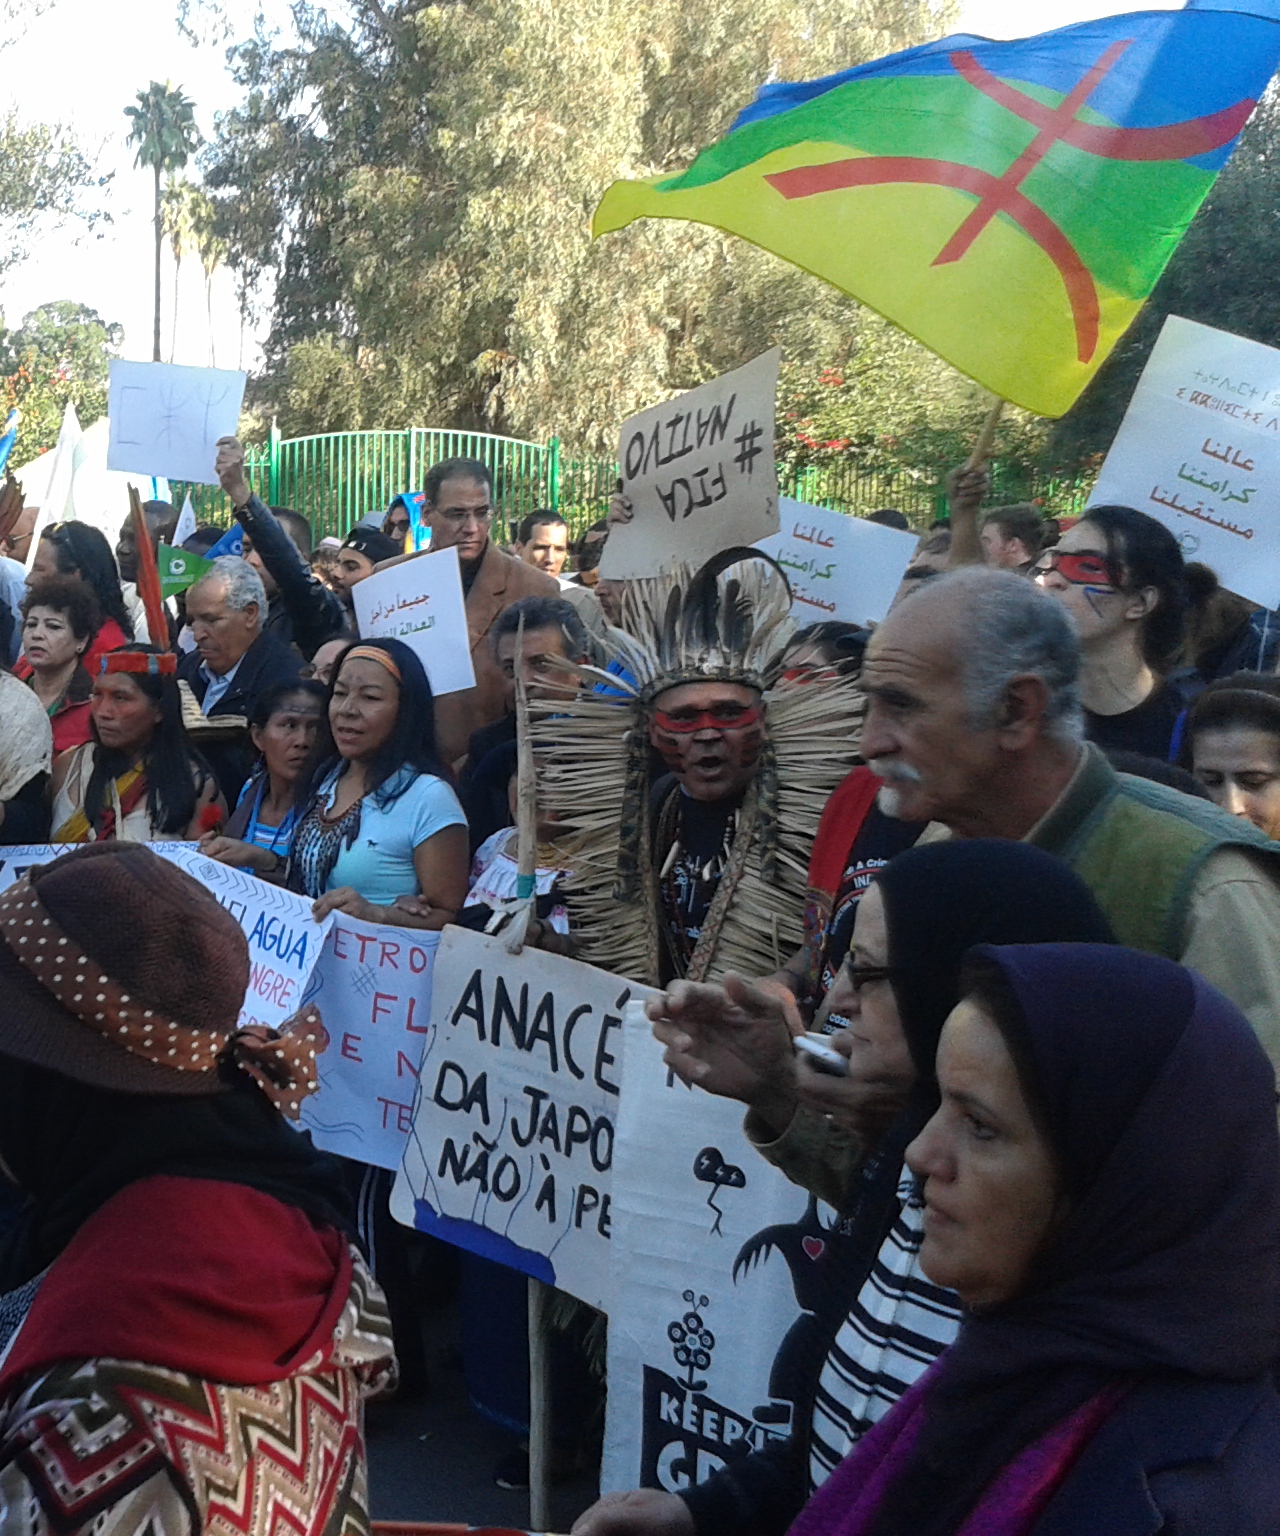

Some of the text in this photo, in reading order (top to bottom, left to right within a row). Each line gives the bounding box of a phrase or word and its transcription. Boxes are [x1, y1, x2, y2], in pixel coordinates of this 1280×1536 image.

[249, 911, 308, 969] AGUA
[326, 927, 428, 974] ETRO
[250, 962, 296, 1008] NGRE
[433, 1060, 490, 1125] DA
[438, 1131, 521, 1201] NÃO
[660, 1391, 744, 1446] KEEP
